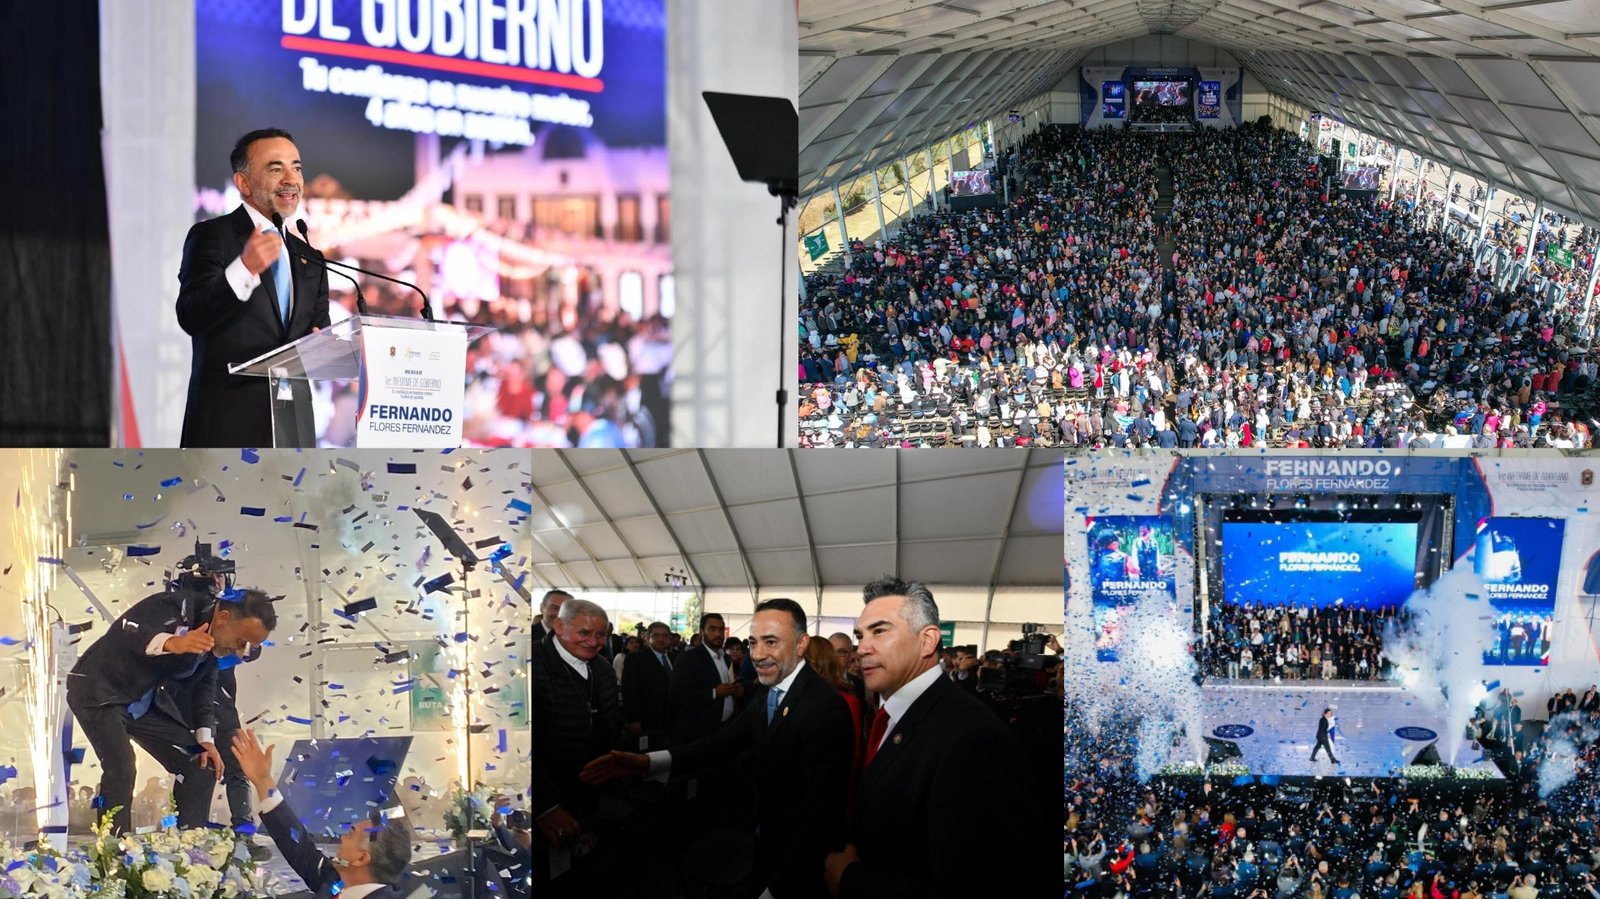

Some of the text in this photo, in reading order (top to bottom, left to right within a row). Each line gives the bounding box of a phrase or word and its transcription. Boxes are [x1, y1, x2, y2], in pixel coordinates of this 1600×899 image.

[370, 404, 452, 422] FERNANDO
[369, 421, 451, 435] FLORES FERNÁNDEZ
[1266, 460, 1391, 476] FERNANDO
[1266, 477, 1390, 489] FLORES FERNÁNDEZ
[1279, 552, 1360, 563] FERNANDO
[1280, 563, 1310, 571] FLORES
[1102, 581, 1167, 589] FERNANDO
[1484, 584, 1549, 592] FERNANDO
